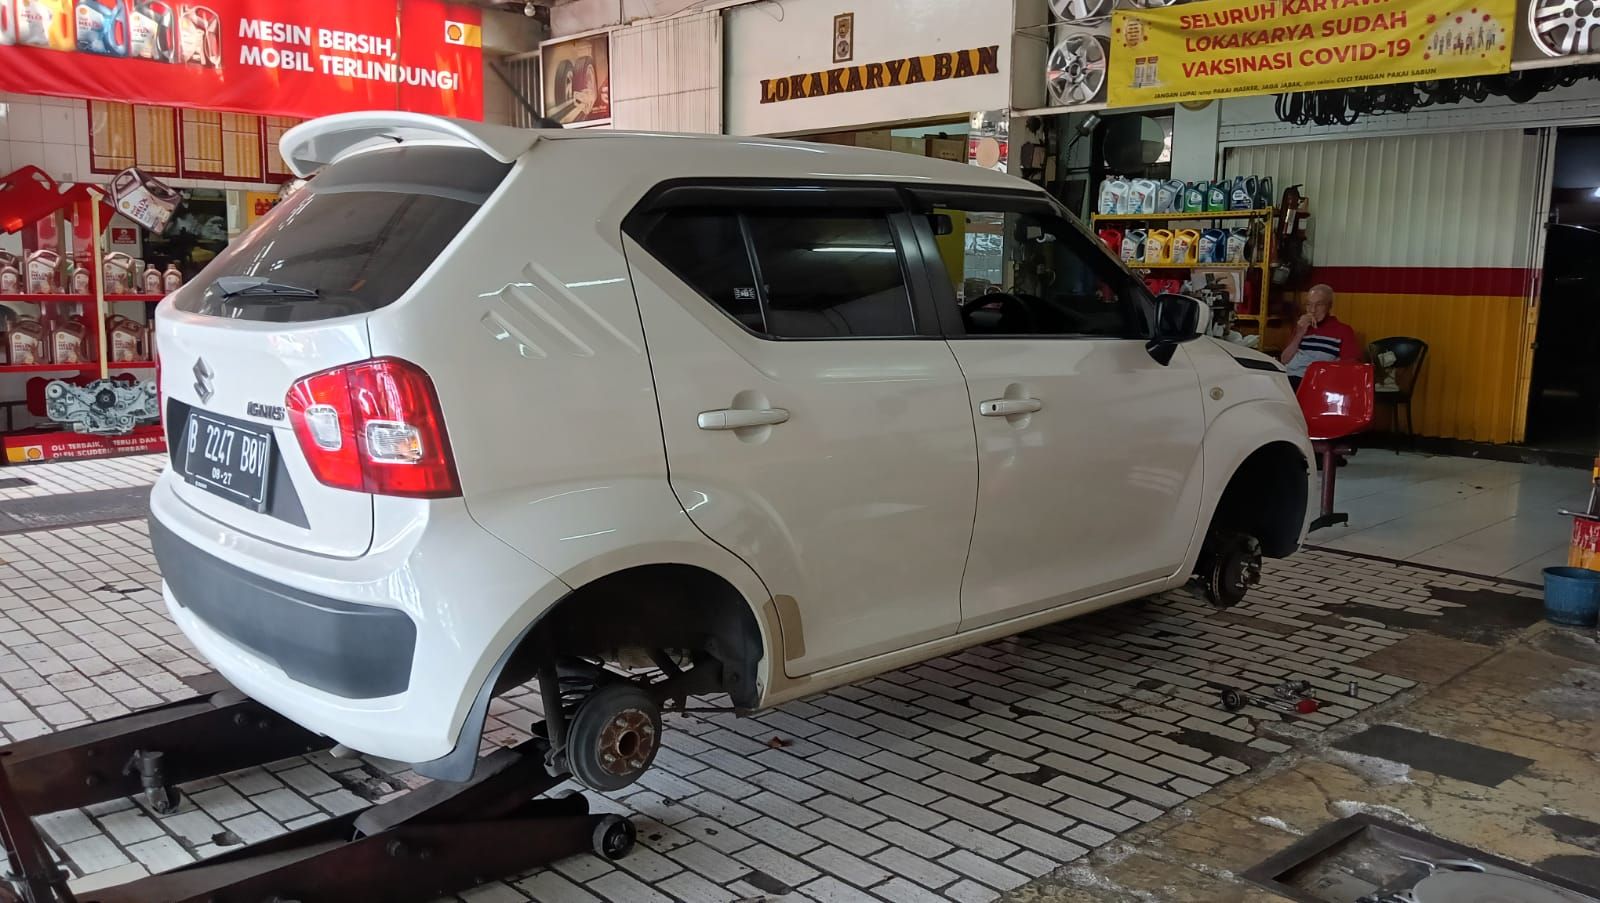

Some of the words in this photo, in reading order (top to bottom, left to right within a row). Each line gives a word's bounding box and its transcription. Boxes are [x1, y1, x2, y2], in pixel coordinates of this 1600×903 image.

[1180, 3, 1275, 30] SELURUH
[1185, 23, 1314, 53] LOKAKARYA
[1322, 10, 1408, 37] SUDAH
[239, 18, 311, 46] MESIN
[319, 28, 397, 60] BERSIH,
[1182, 52, 1293, 79] VAKSINASI
[1301, 38, 1411, 67] COVID-19
[240, 45, 314, 73] MOBIL
[319, 55, 458, 91] TERLINDUNGI
[760, 56, 926, 104] LOKAKARYA
[934, 45, 999, 80] BAN
[1337, 75, 1352, 83] CUCI
[1354, 73, 1385, 82] TANGAN
[1387, 70, 1409, 78] PAKAI
[1411, 68, 1437, 76] SABUN
[246, 401, 285, 421] IGNIS
[51, 444, 65, 452] OLI
[189, 419, 199, 453] B
[205, 425, 235, 466] 2247
